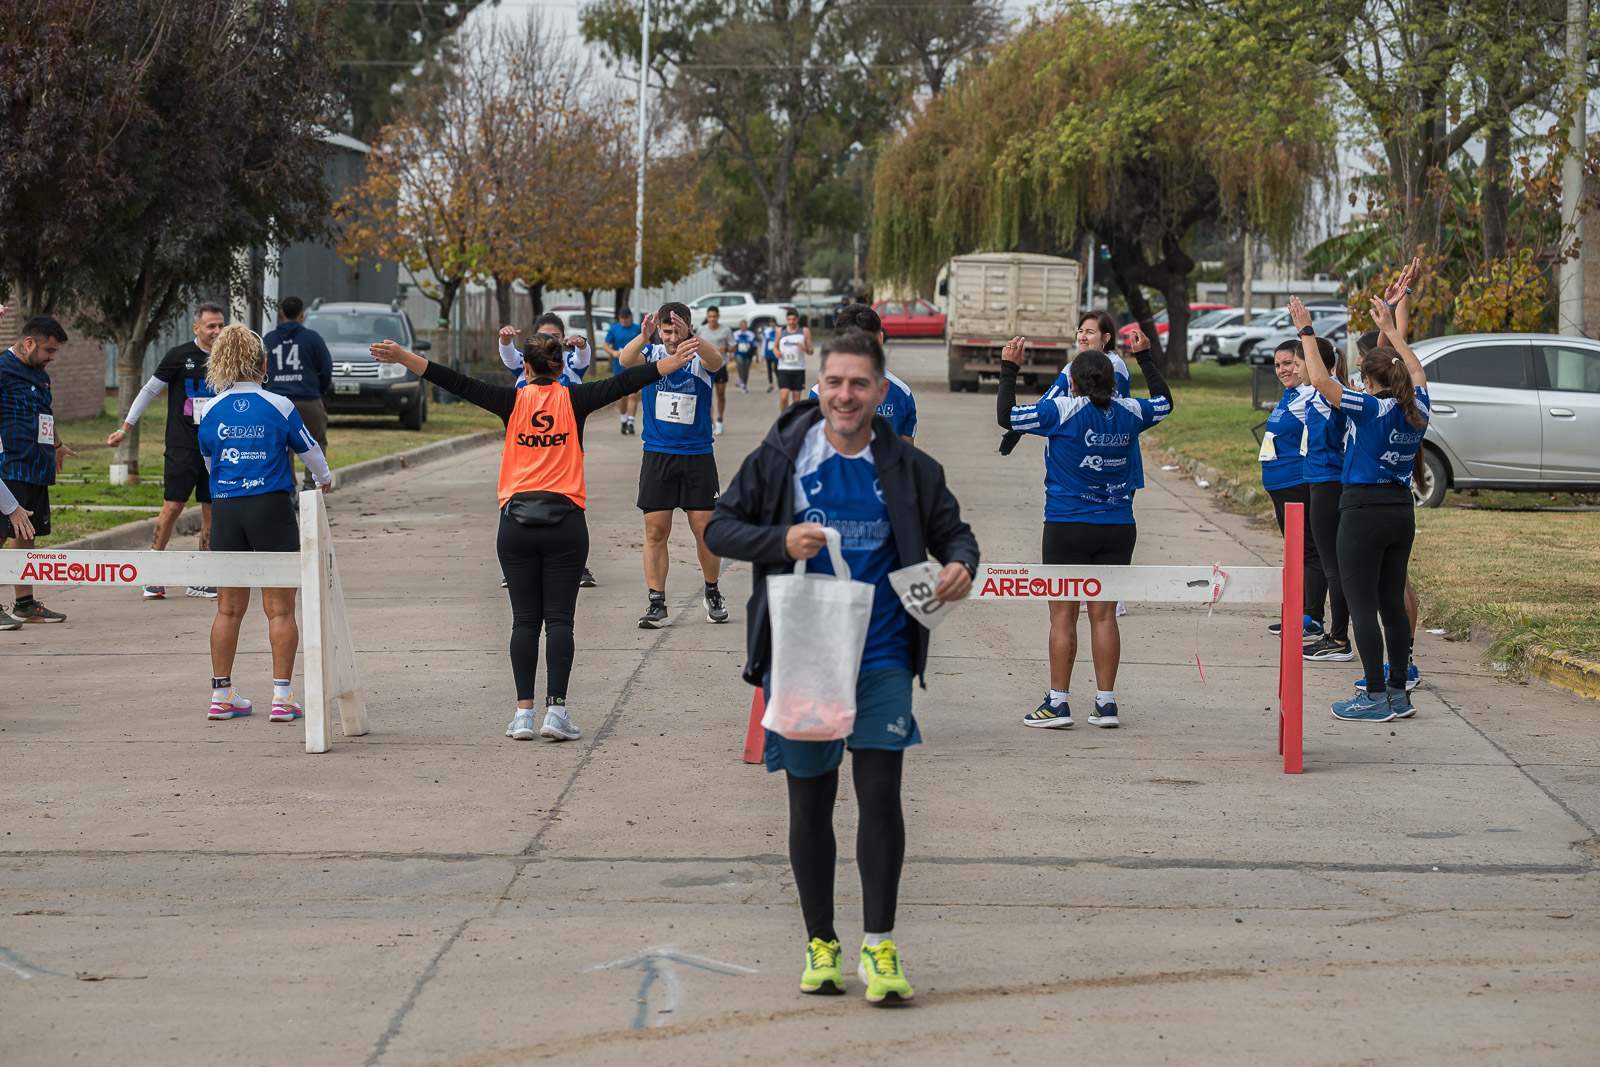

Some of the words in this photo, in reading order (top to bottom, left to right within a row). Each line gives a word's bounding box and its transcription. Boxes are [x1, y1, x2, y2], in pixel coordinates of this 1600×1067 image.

[670, 402, 679, 416] 1
[217, 422, 265, 441] CEDAR
[1084, 428, 1130, 447] CEDAR
[26, 552, 56, 560] Comuna
[57, 552, 67, 560] de
[20, 562, 138, 582] AREQUITO
[987, 567, 1018, 575] Comuna
[1019, 567, 1029, 575] de
[980, 578, 1102, 597] AREQUITO
